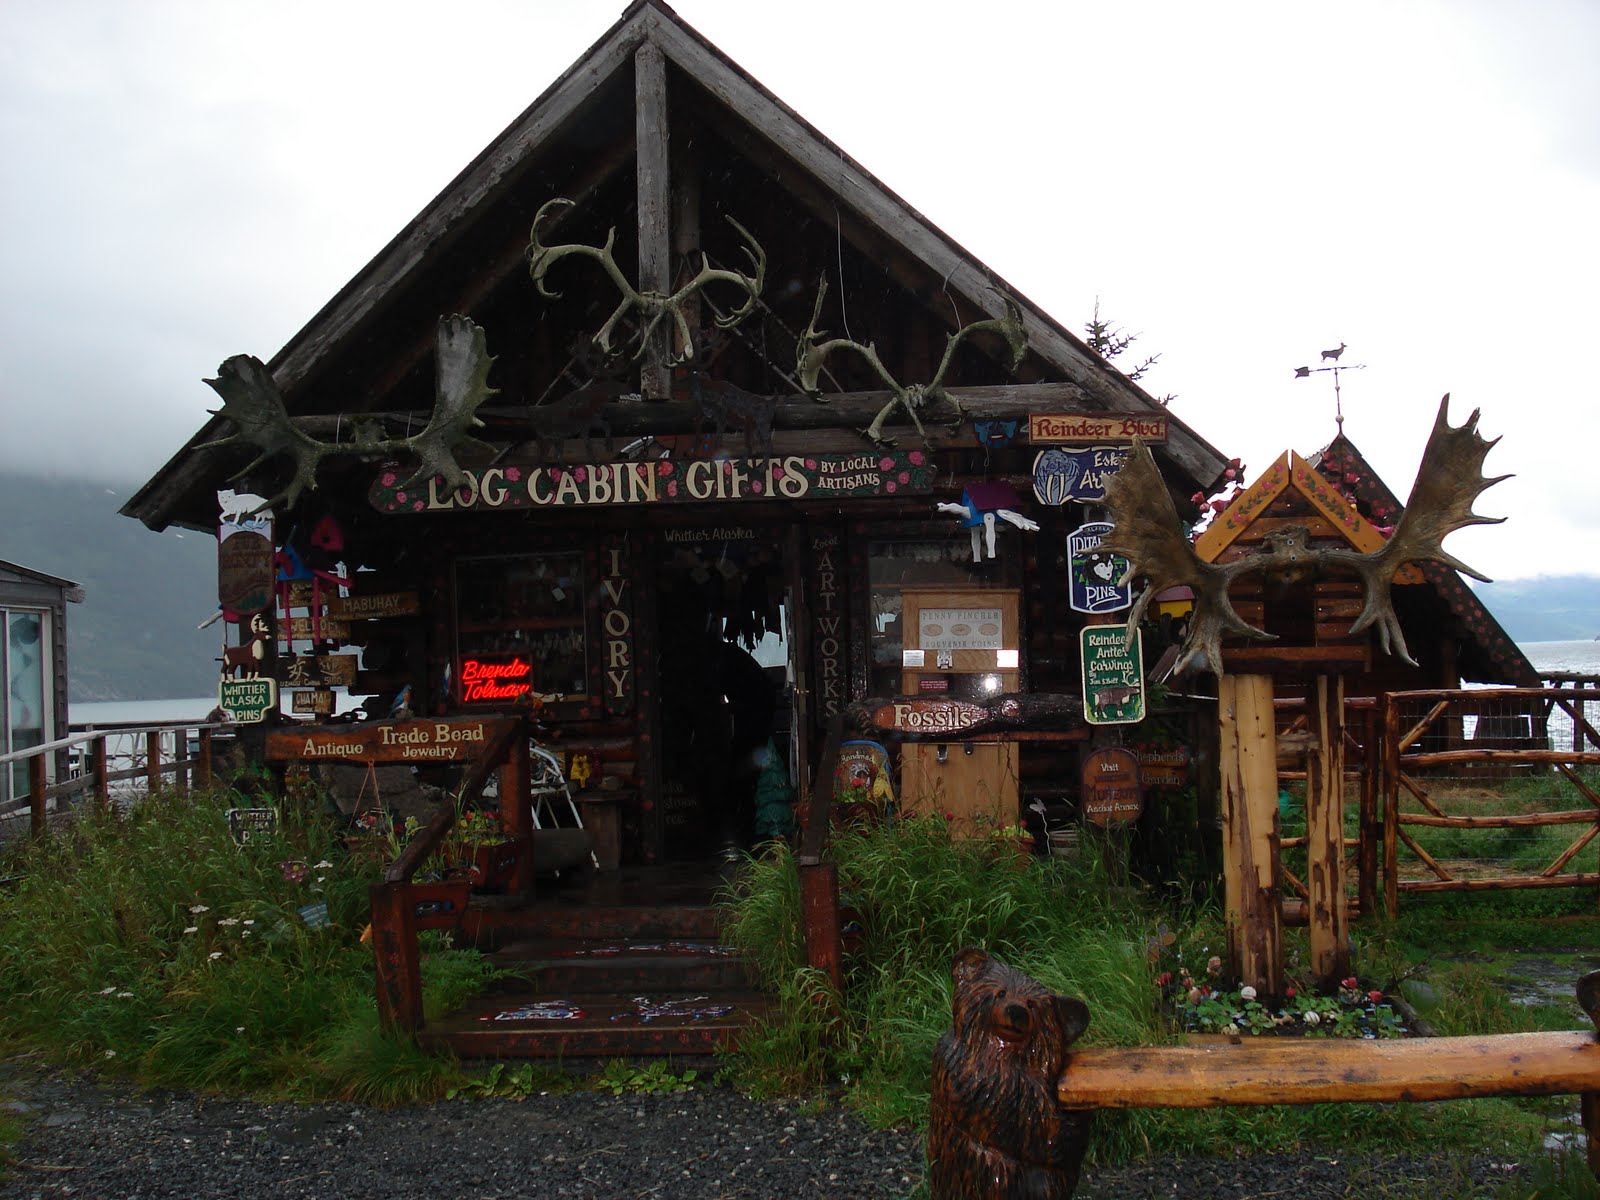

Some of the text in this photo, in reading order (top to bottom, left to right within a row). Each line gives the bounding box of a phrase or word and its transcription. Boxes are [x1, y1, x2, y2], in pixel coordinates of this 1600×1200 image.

[1037, 417, 1164, 437] Reindeer Blvd.
[820, 456, 877, 474] BY LOCAL
[427, 456, 809, 510] LOG CABIN GIFTS
[817, 473, 881, 491] ARTISANS
[343, 594, 400, 612] MABUHAY
[1085, 585, 1122, 609] PINS
[603, 549, 630, 699] IVORY
[922, 611, 999, 620] PENNY PINCHER
[1088, 633, 1127, 647] Reindee
[462, 657, 531, 680] Brenda
[1090, 659, 1134, 673] Carvings
[223, 684, 267, 696] WHITTIER
[463, 679, 532, 702] Tolman
[223, 695, 265, 707] ALASKA
[235, 709, 261, 722] PINS
[893, 704, 975, 728] Fossils
[377, 724, 485, 745] Trade Bead
[302, 738, 364, 757] Antique
[402, 744, 458, 759] Jewelry
[1100, 762, 1120, 772] Visit
